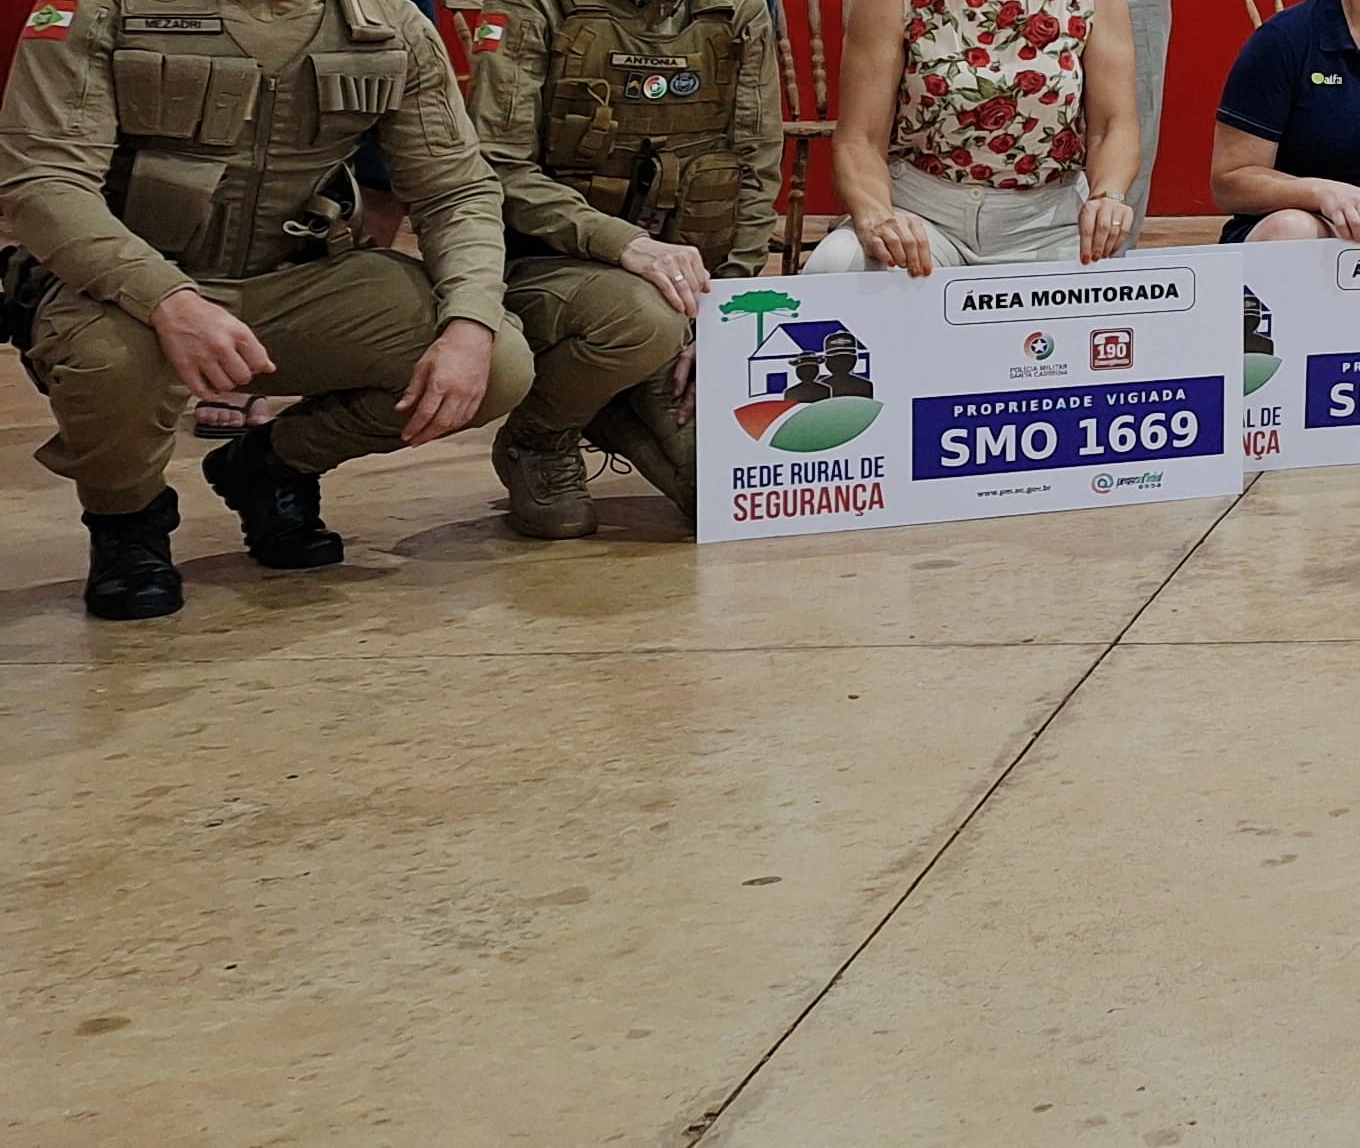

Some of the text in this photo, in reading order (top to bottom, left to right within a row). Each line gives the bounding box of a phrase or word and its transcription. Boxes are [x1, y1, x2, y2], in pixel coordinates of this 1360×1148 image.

[624, 57, 677, 66] ANTONIA
[962, 283, 1178, 311] ÁREA MONITORADA
[1096, 343, 1127, 361] 190
[954, 389, 1185, 417] PROPRIEDADE VIGIADA
[1261, 407, 1281, 426] DE
[941, 411, 1197, 466] SMO 1669
[733, 456, 884, 489] REDE RURAL DE
[734, 483, 884, 521] SEGURANÇA
